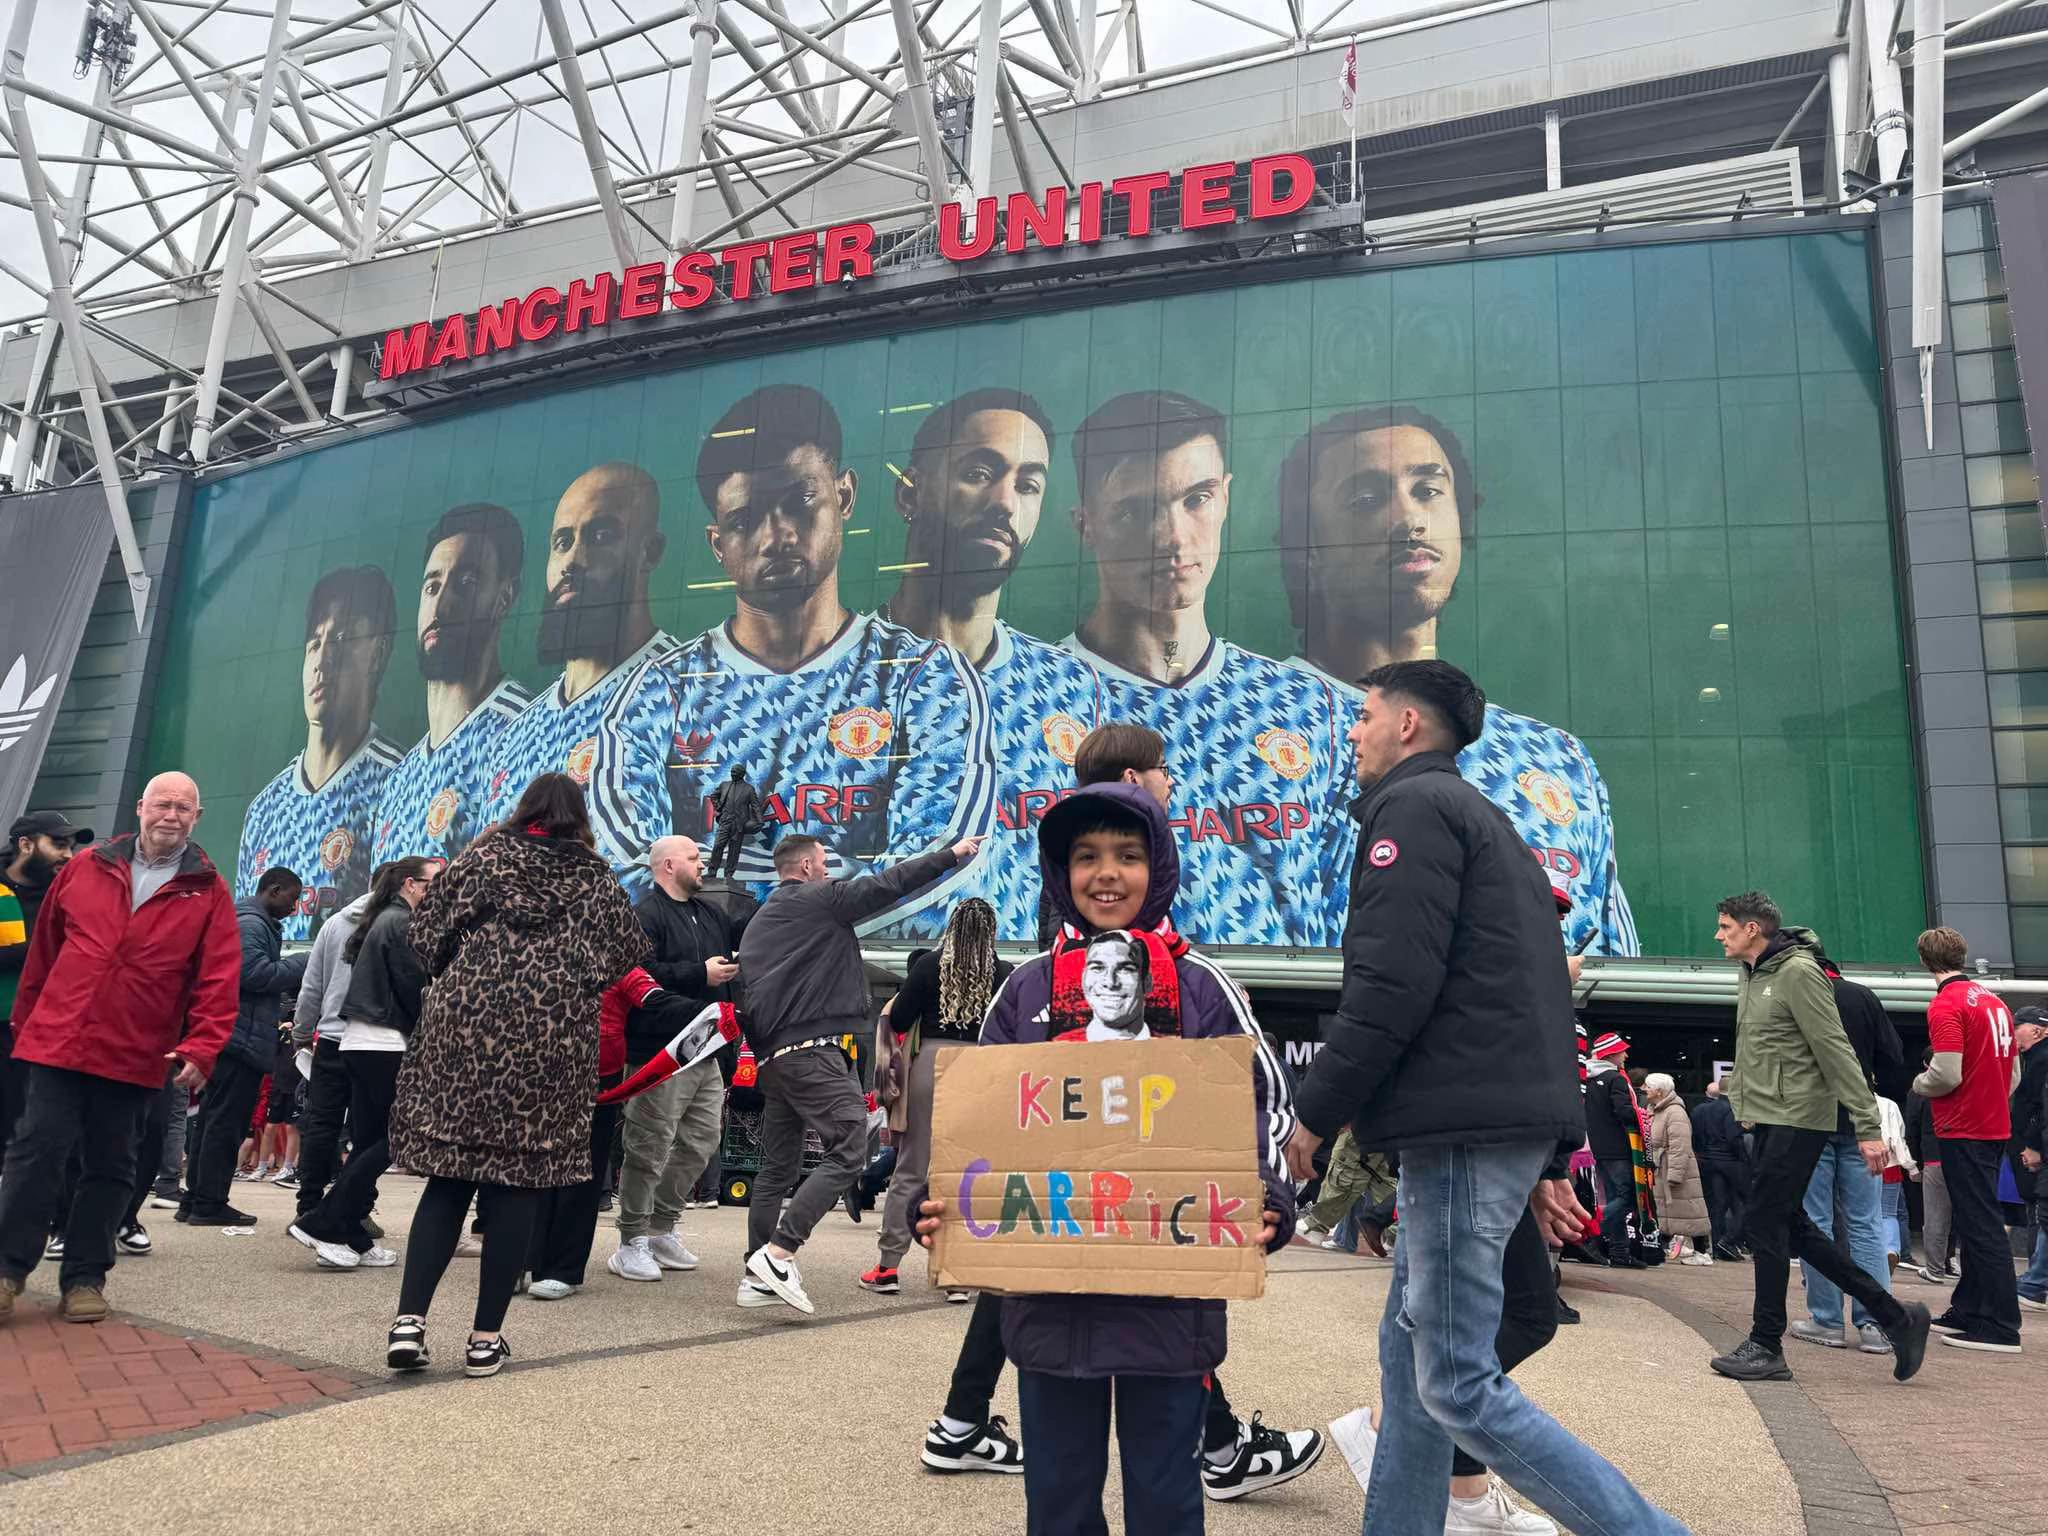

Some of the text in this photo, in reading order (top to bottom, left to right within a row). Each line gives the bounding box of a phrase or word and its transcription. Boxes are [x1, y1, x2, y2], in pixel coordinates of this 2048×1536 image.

[380, 153, 1316, 381] MANCHESTER UNITED
[1986, 1007, 2013, 1058] 14
[1017, 1071, 1177, 1142] KEEP
